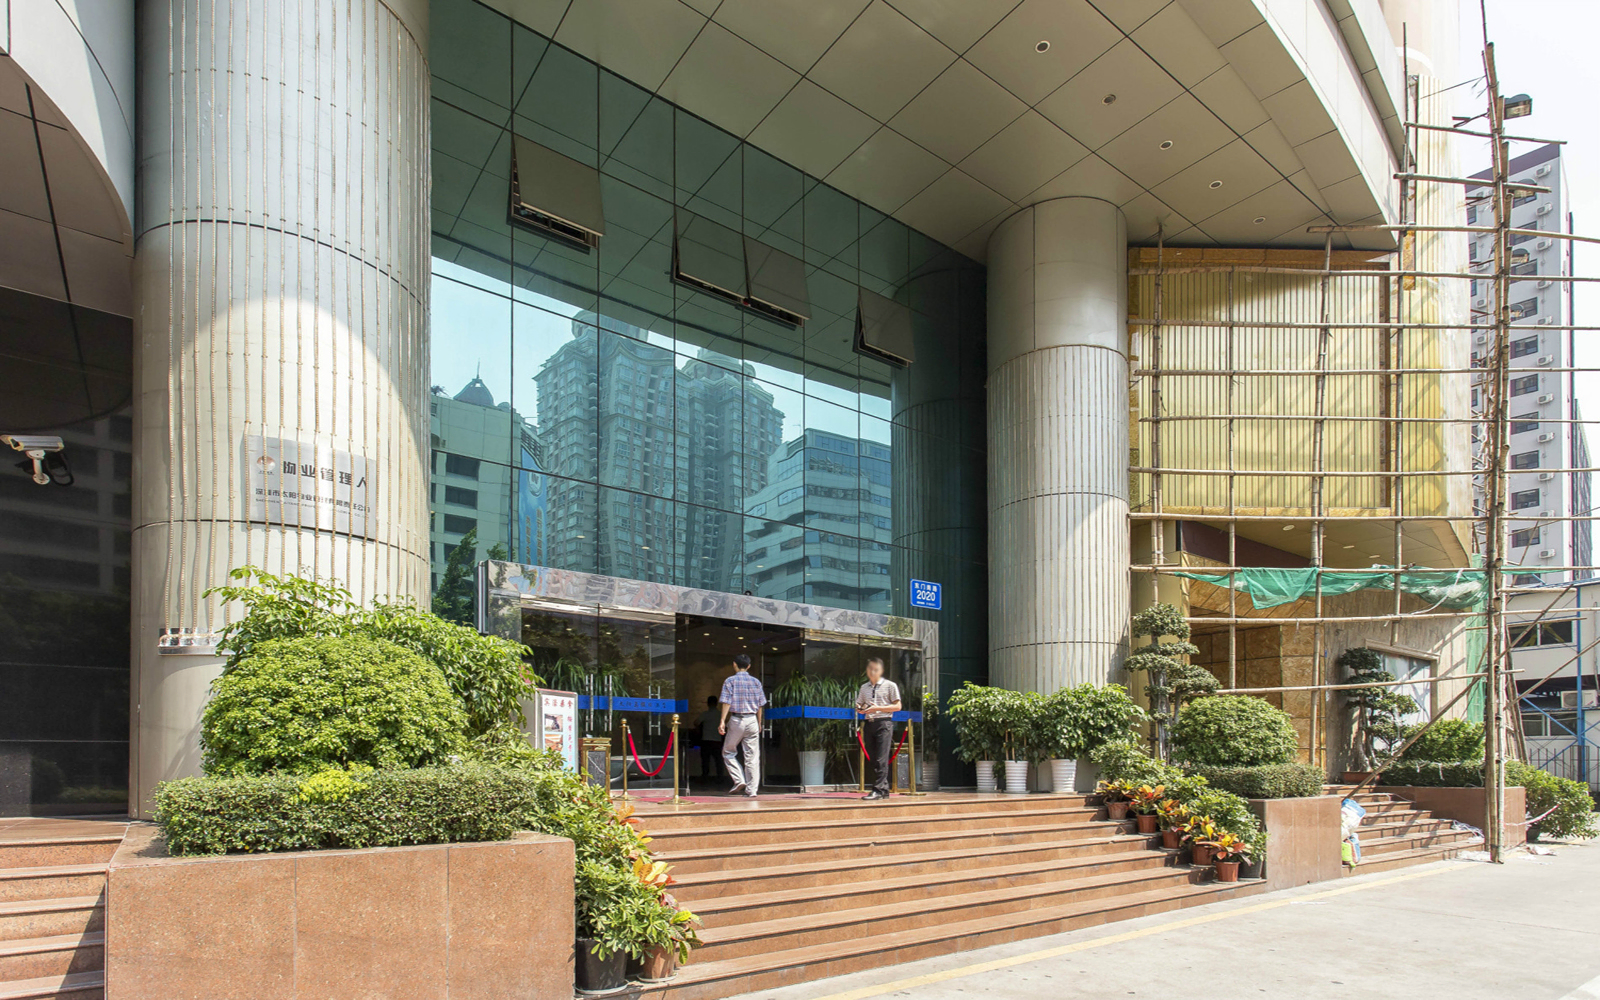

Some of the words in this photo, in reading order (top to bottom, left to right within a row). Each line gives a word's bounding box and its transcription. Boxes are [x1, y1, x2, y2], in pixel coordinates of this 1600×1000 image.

[283, 460, 368, 488] 物业管理人
[916, 589, 936, 602] 2020
